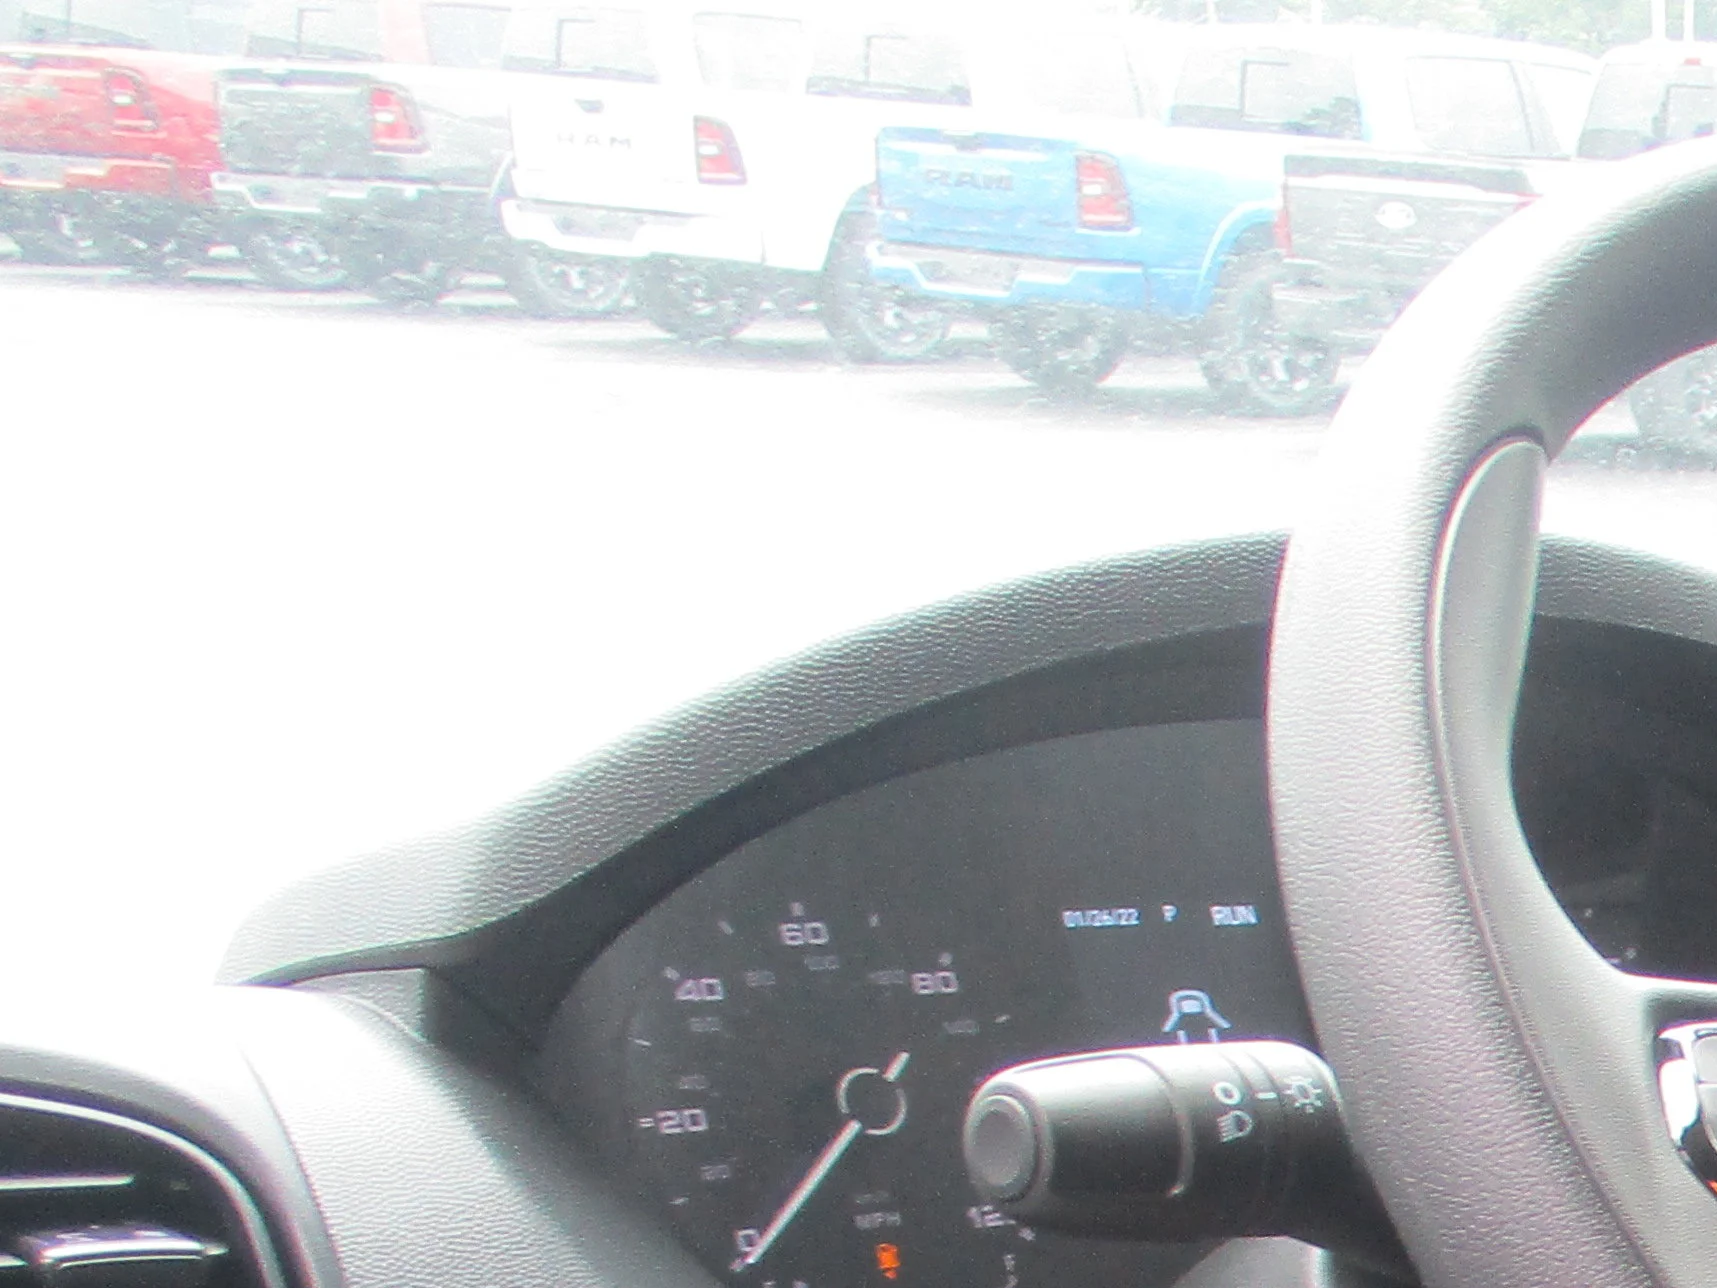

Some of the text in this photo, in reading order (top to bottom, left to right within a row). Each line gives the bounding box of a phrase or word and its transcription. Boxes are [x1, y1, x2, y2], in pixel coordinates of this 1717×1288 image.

[924, 168, 1014, 192] RAM
[1209, 904, 1260, 926] RUN
[779, 922, 830, 946] 60
[674, 977, 726, 1001] 40
[910, 970, 960, 996] 80
[656, 1108, 708, 1135] 20
